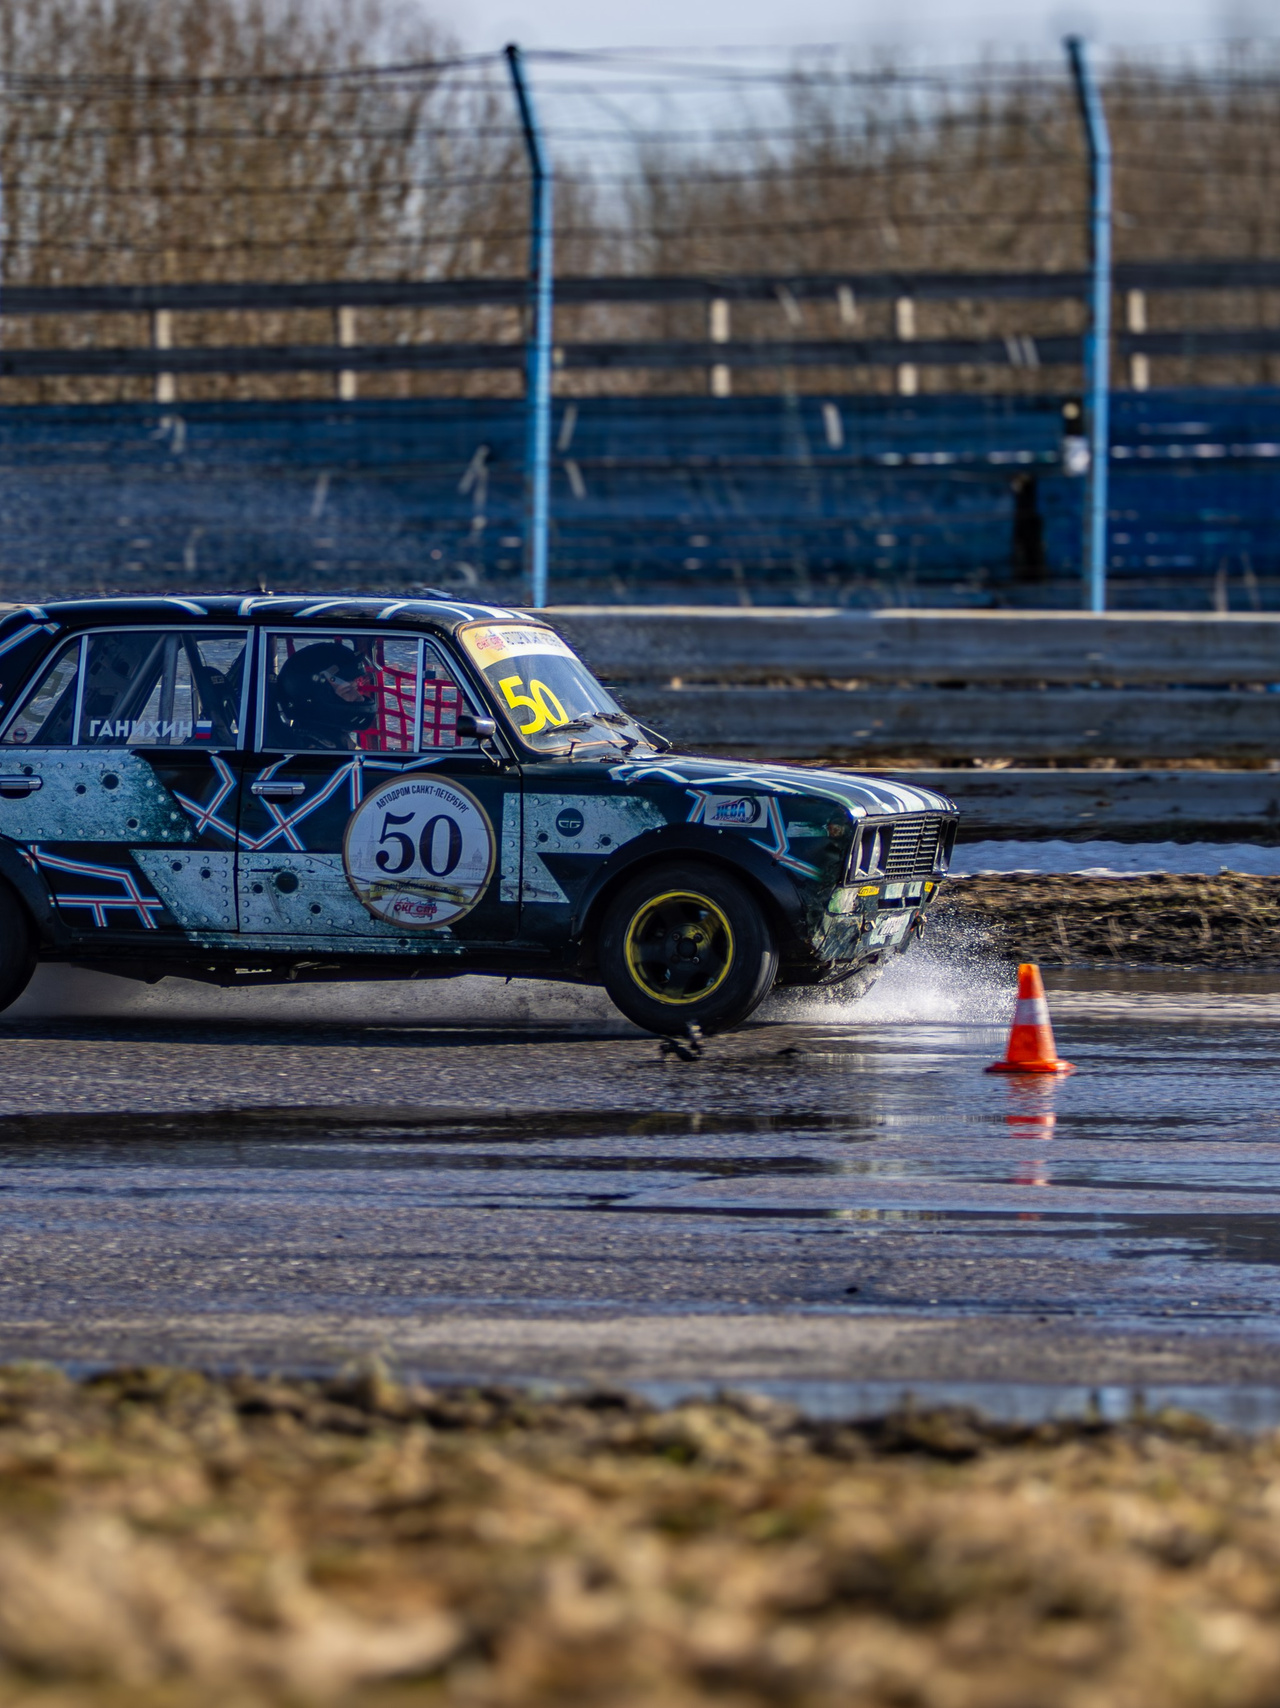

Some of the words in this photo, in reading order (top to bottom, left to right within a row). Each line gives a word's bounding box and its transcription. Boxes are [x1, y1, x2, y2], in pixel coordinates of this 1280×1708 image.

[498, 675, 569, 735] 50
[89, 720, 193, 738] ГАНИХИН
[376, 786, 410, 810] АВТОДРОМ
[412, 785, 470, 813] САНКТ-ПЕТЕРБУРГ
[376, 812, 463, 877] 50
